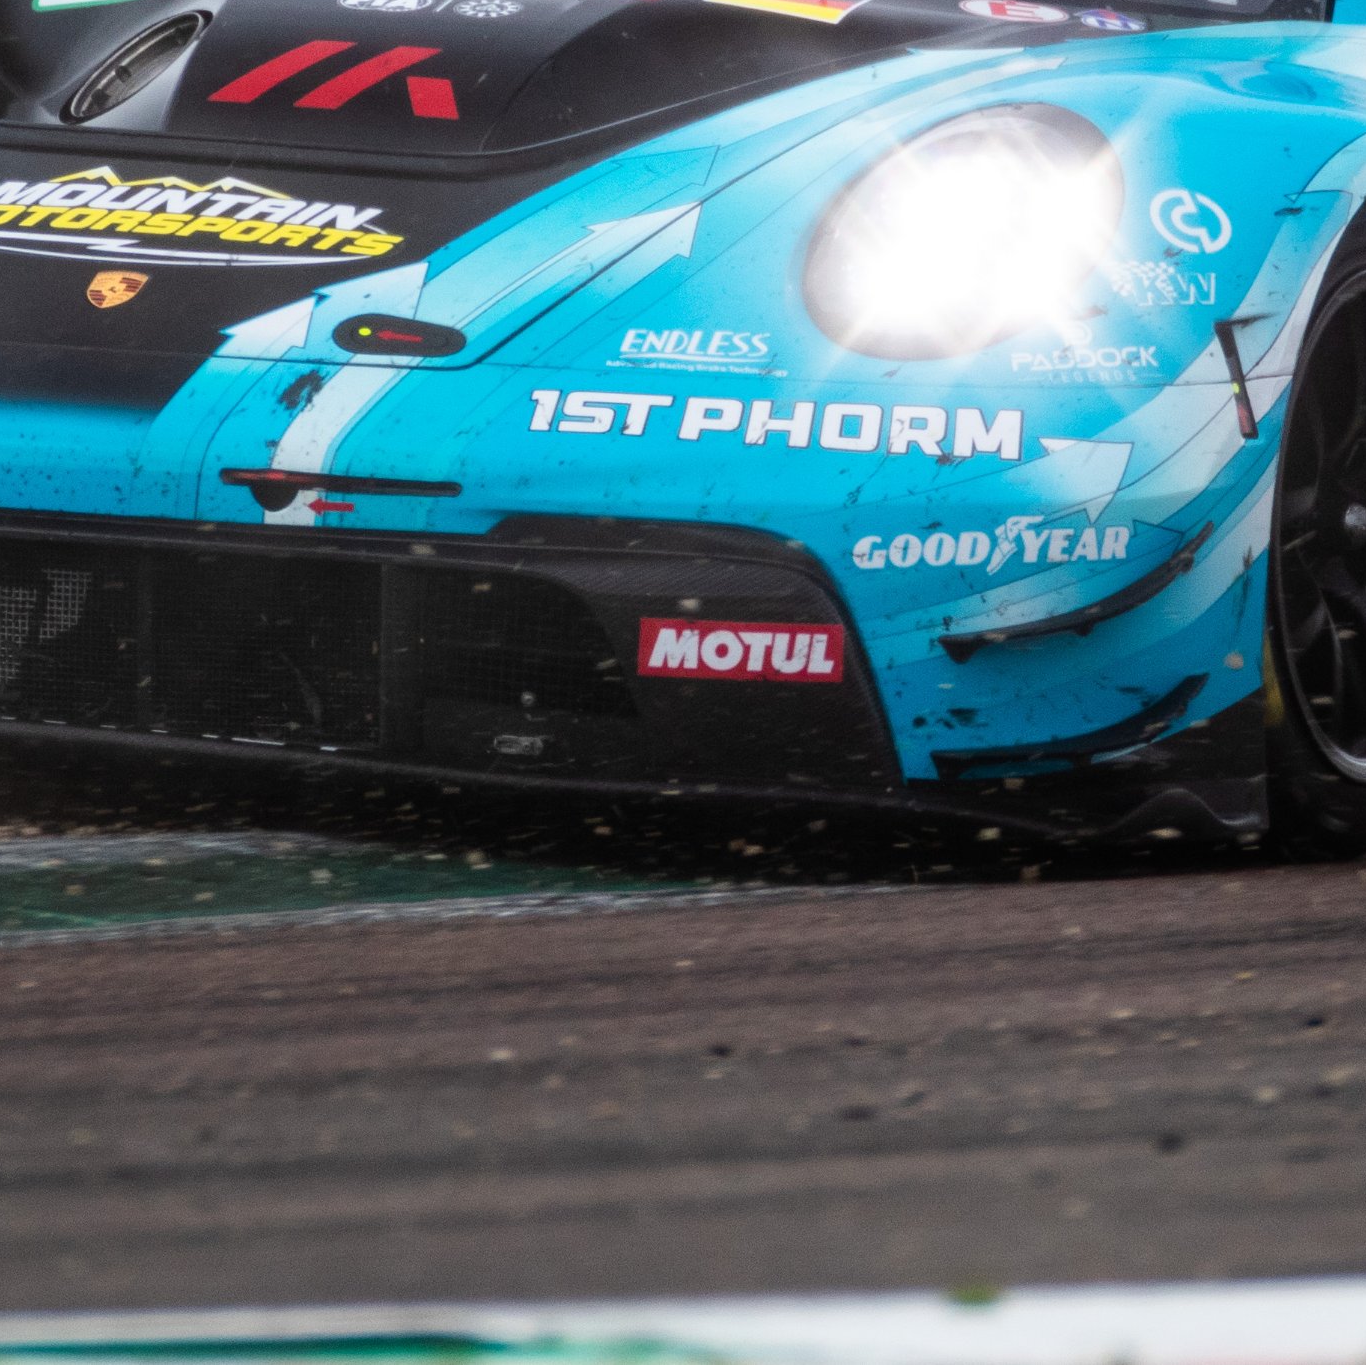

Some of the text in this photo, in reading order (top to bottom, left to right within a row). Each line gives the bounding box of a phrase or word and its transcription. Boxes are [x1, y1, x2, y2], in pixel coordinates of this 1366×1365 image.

[620, 328, 771, 357] ENDLESS
[1010, 345, 1159, 373] PADDOCK
[530, 389, 1024, 462] 1ST PHORM
[852, 515, 1131, 576] GOODYEAR
[646, 626, 836, 675] MOTUL
